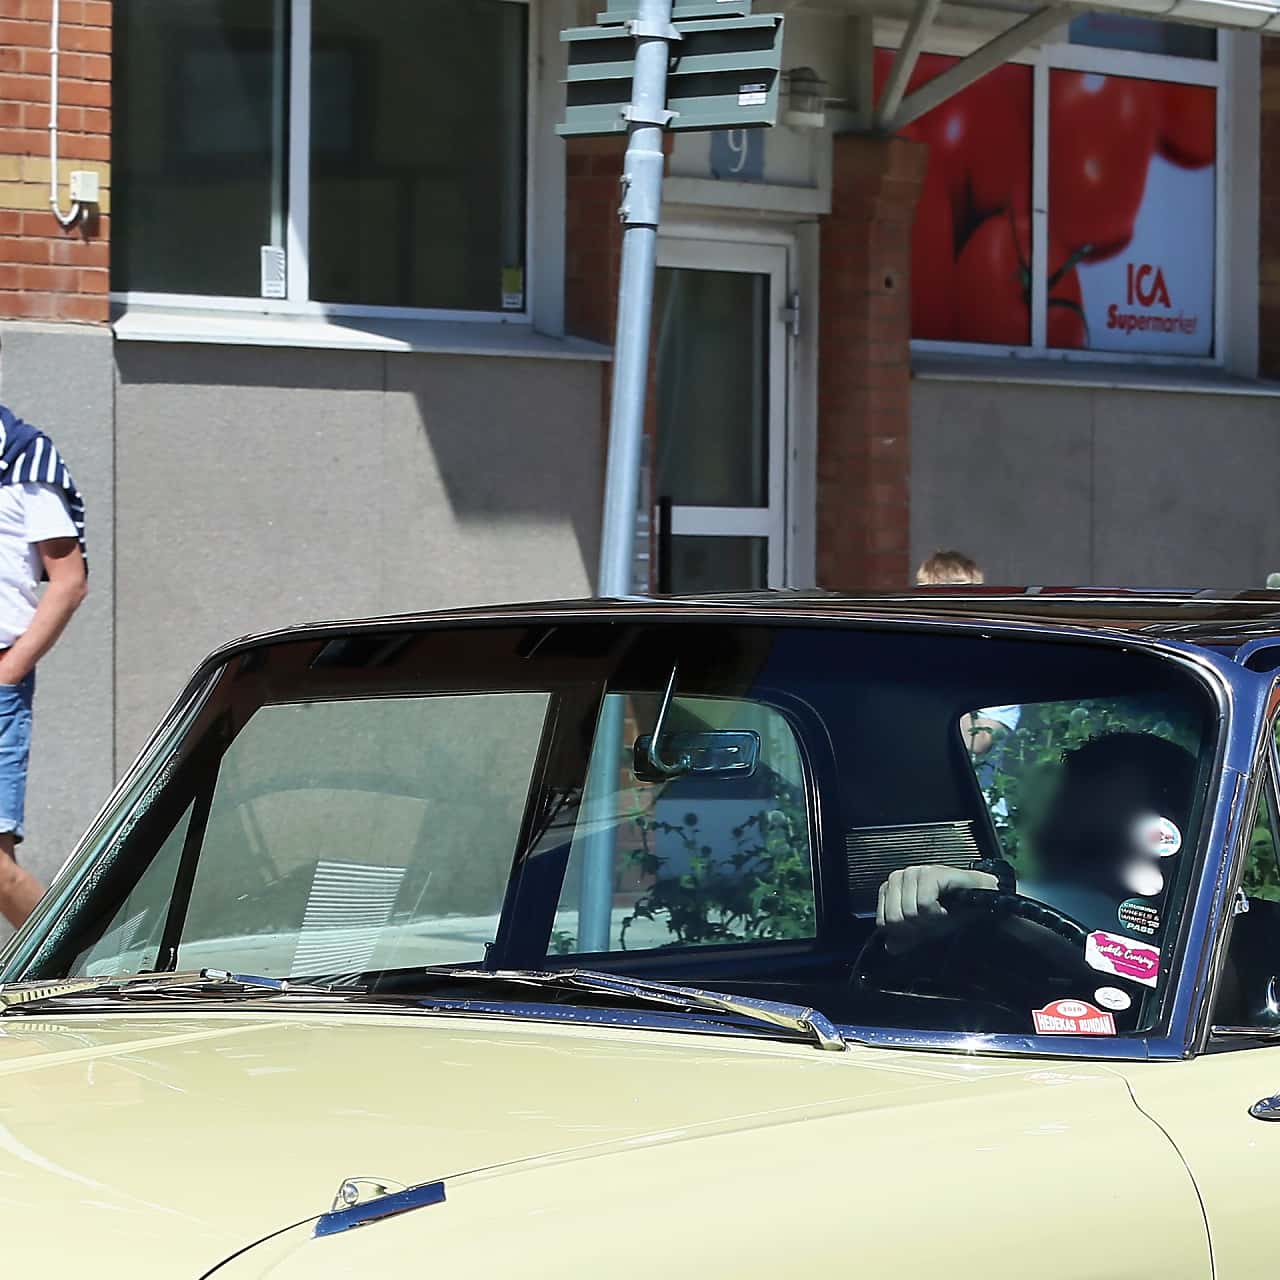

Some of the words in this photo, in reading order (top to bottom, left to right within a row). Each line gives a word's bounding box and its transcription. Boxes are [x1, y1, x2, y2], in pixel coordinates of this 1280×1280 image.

[727, 129, 748, 173] 9
[1126, 263, 1172, 308] ICA
[1106, 304, 1198, 336] Supermarket
